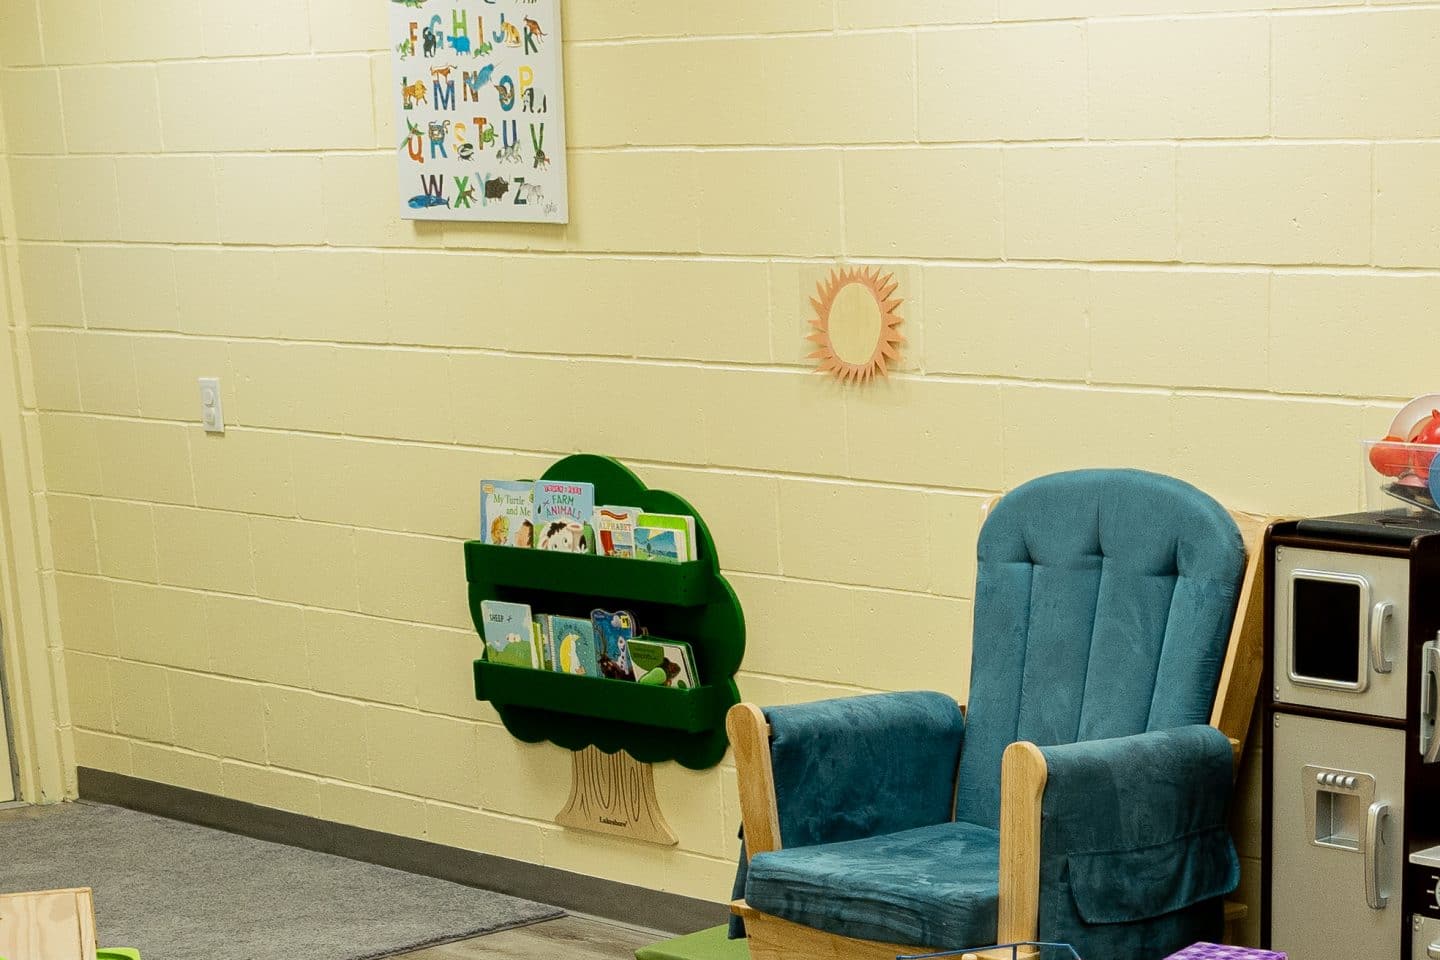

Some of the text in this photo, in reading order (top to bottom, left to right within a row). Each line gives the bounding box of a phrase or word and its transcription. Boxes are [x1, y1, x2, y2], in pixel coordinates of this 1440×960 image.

[493, 494, 525, 505] My Turtle
[552, 495, 574, 505] FARM
[506, 507, 531, 517] and Me
[546, 506, 582, 520] ANIMALS
